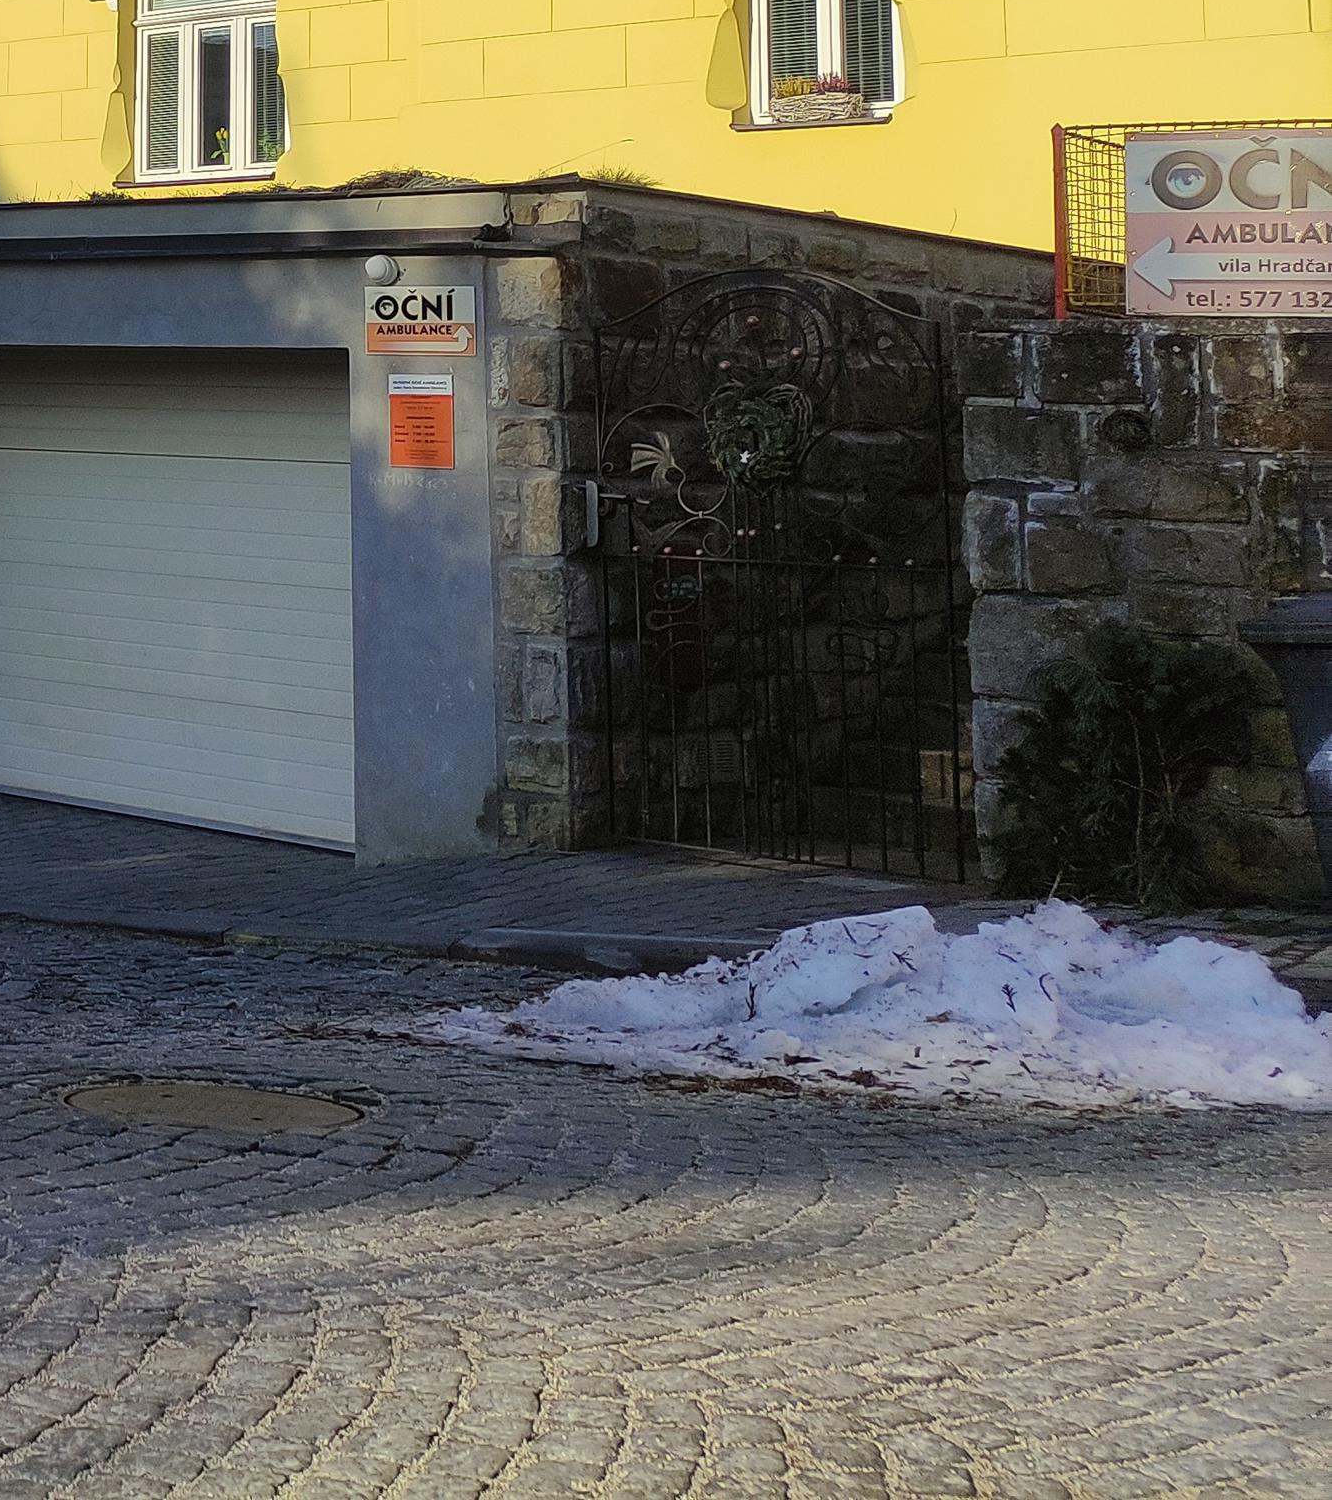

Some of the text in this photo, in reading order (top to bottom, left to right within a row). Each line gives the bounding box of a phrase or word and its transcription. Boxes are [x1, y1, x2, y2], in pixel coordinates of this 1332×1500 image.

[1218, 258, 1251, 274] vila
[374, 288, 456, 321] OČNÍ
[1186, 289, 1232, 309] tel.:
[1239, 290, 1282, 308] 577
[376, 324, 453, 336] AMBULANCE
